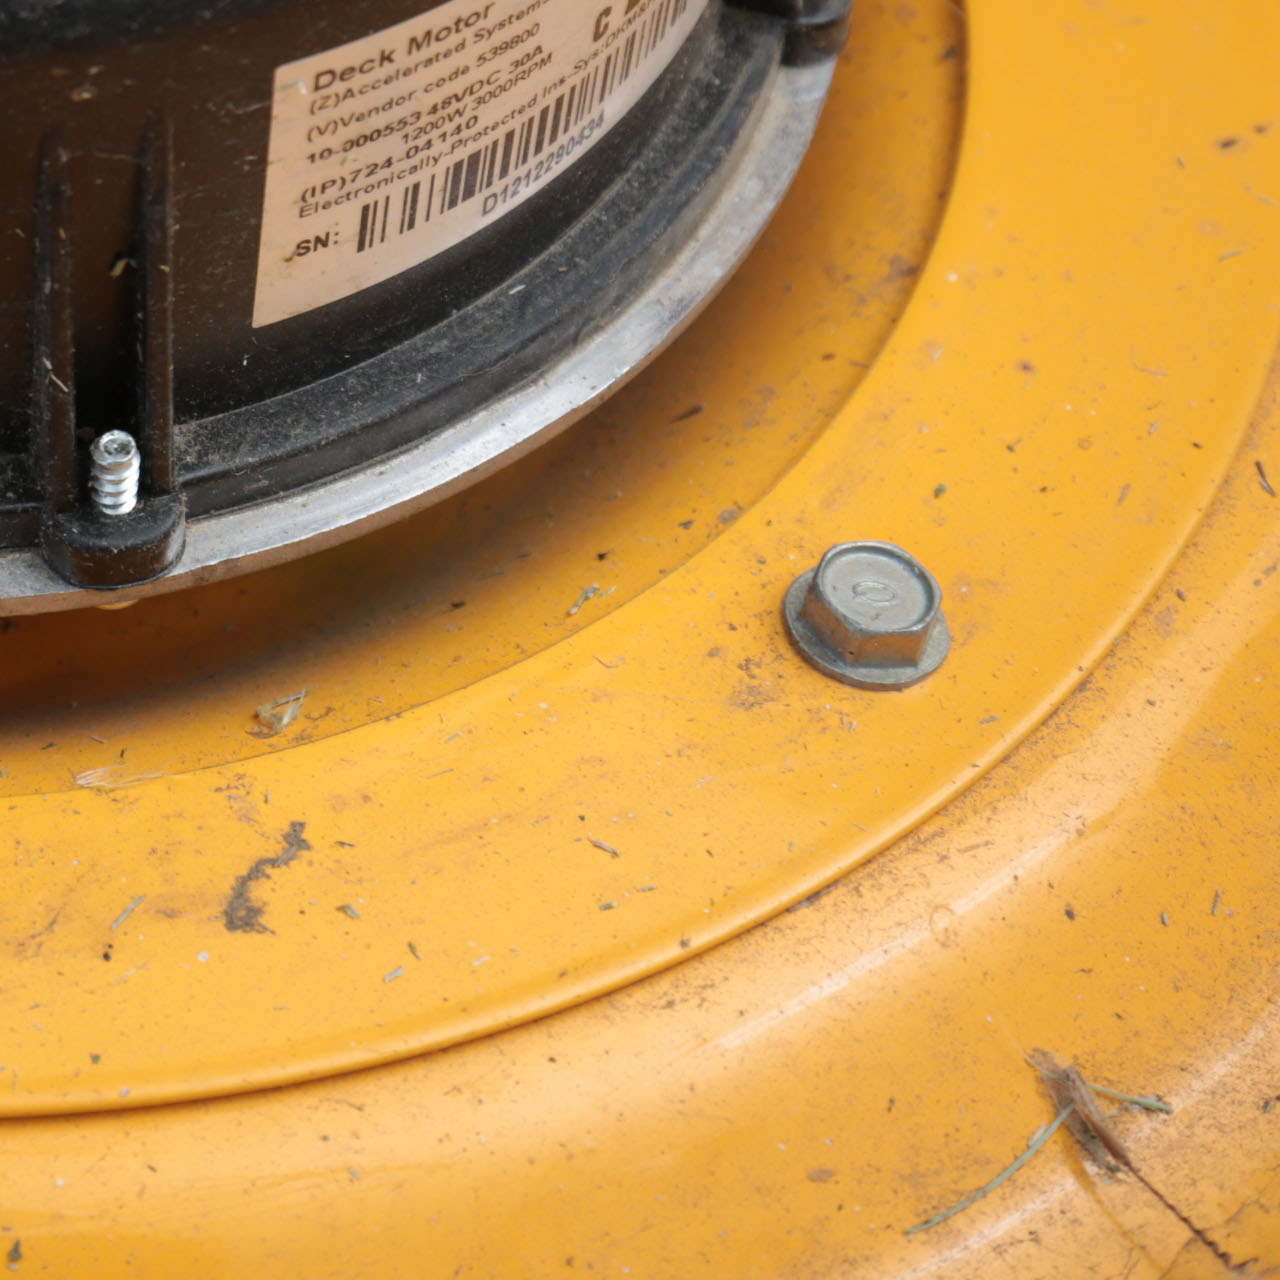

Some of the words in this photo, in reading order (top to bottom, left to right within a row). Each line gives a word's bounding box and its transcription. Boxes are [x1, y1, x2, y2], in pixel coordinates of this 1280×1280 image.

[307, 89, 418, 143] (V)Vendor
[423, 64, 471, 94] code
[475, 21, 541, 68] 539800
[309, 37, 468, 117] (Z)Accelerated
[313, 48, 396, 93] Deck
[407, 1, 497, 57] Motor
[307, 111, 422, 165] 10-000553
[426, 70, 502, 117] 48VDC
[508, 44, 544, 75] 30A
[401, 103, 468, 146] 1200W
[471, 51, 554, 113] 3000RPM
[298, 93, 538, 219] Electronically-Protected
[295, 231, 340, 257] SN:
